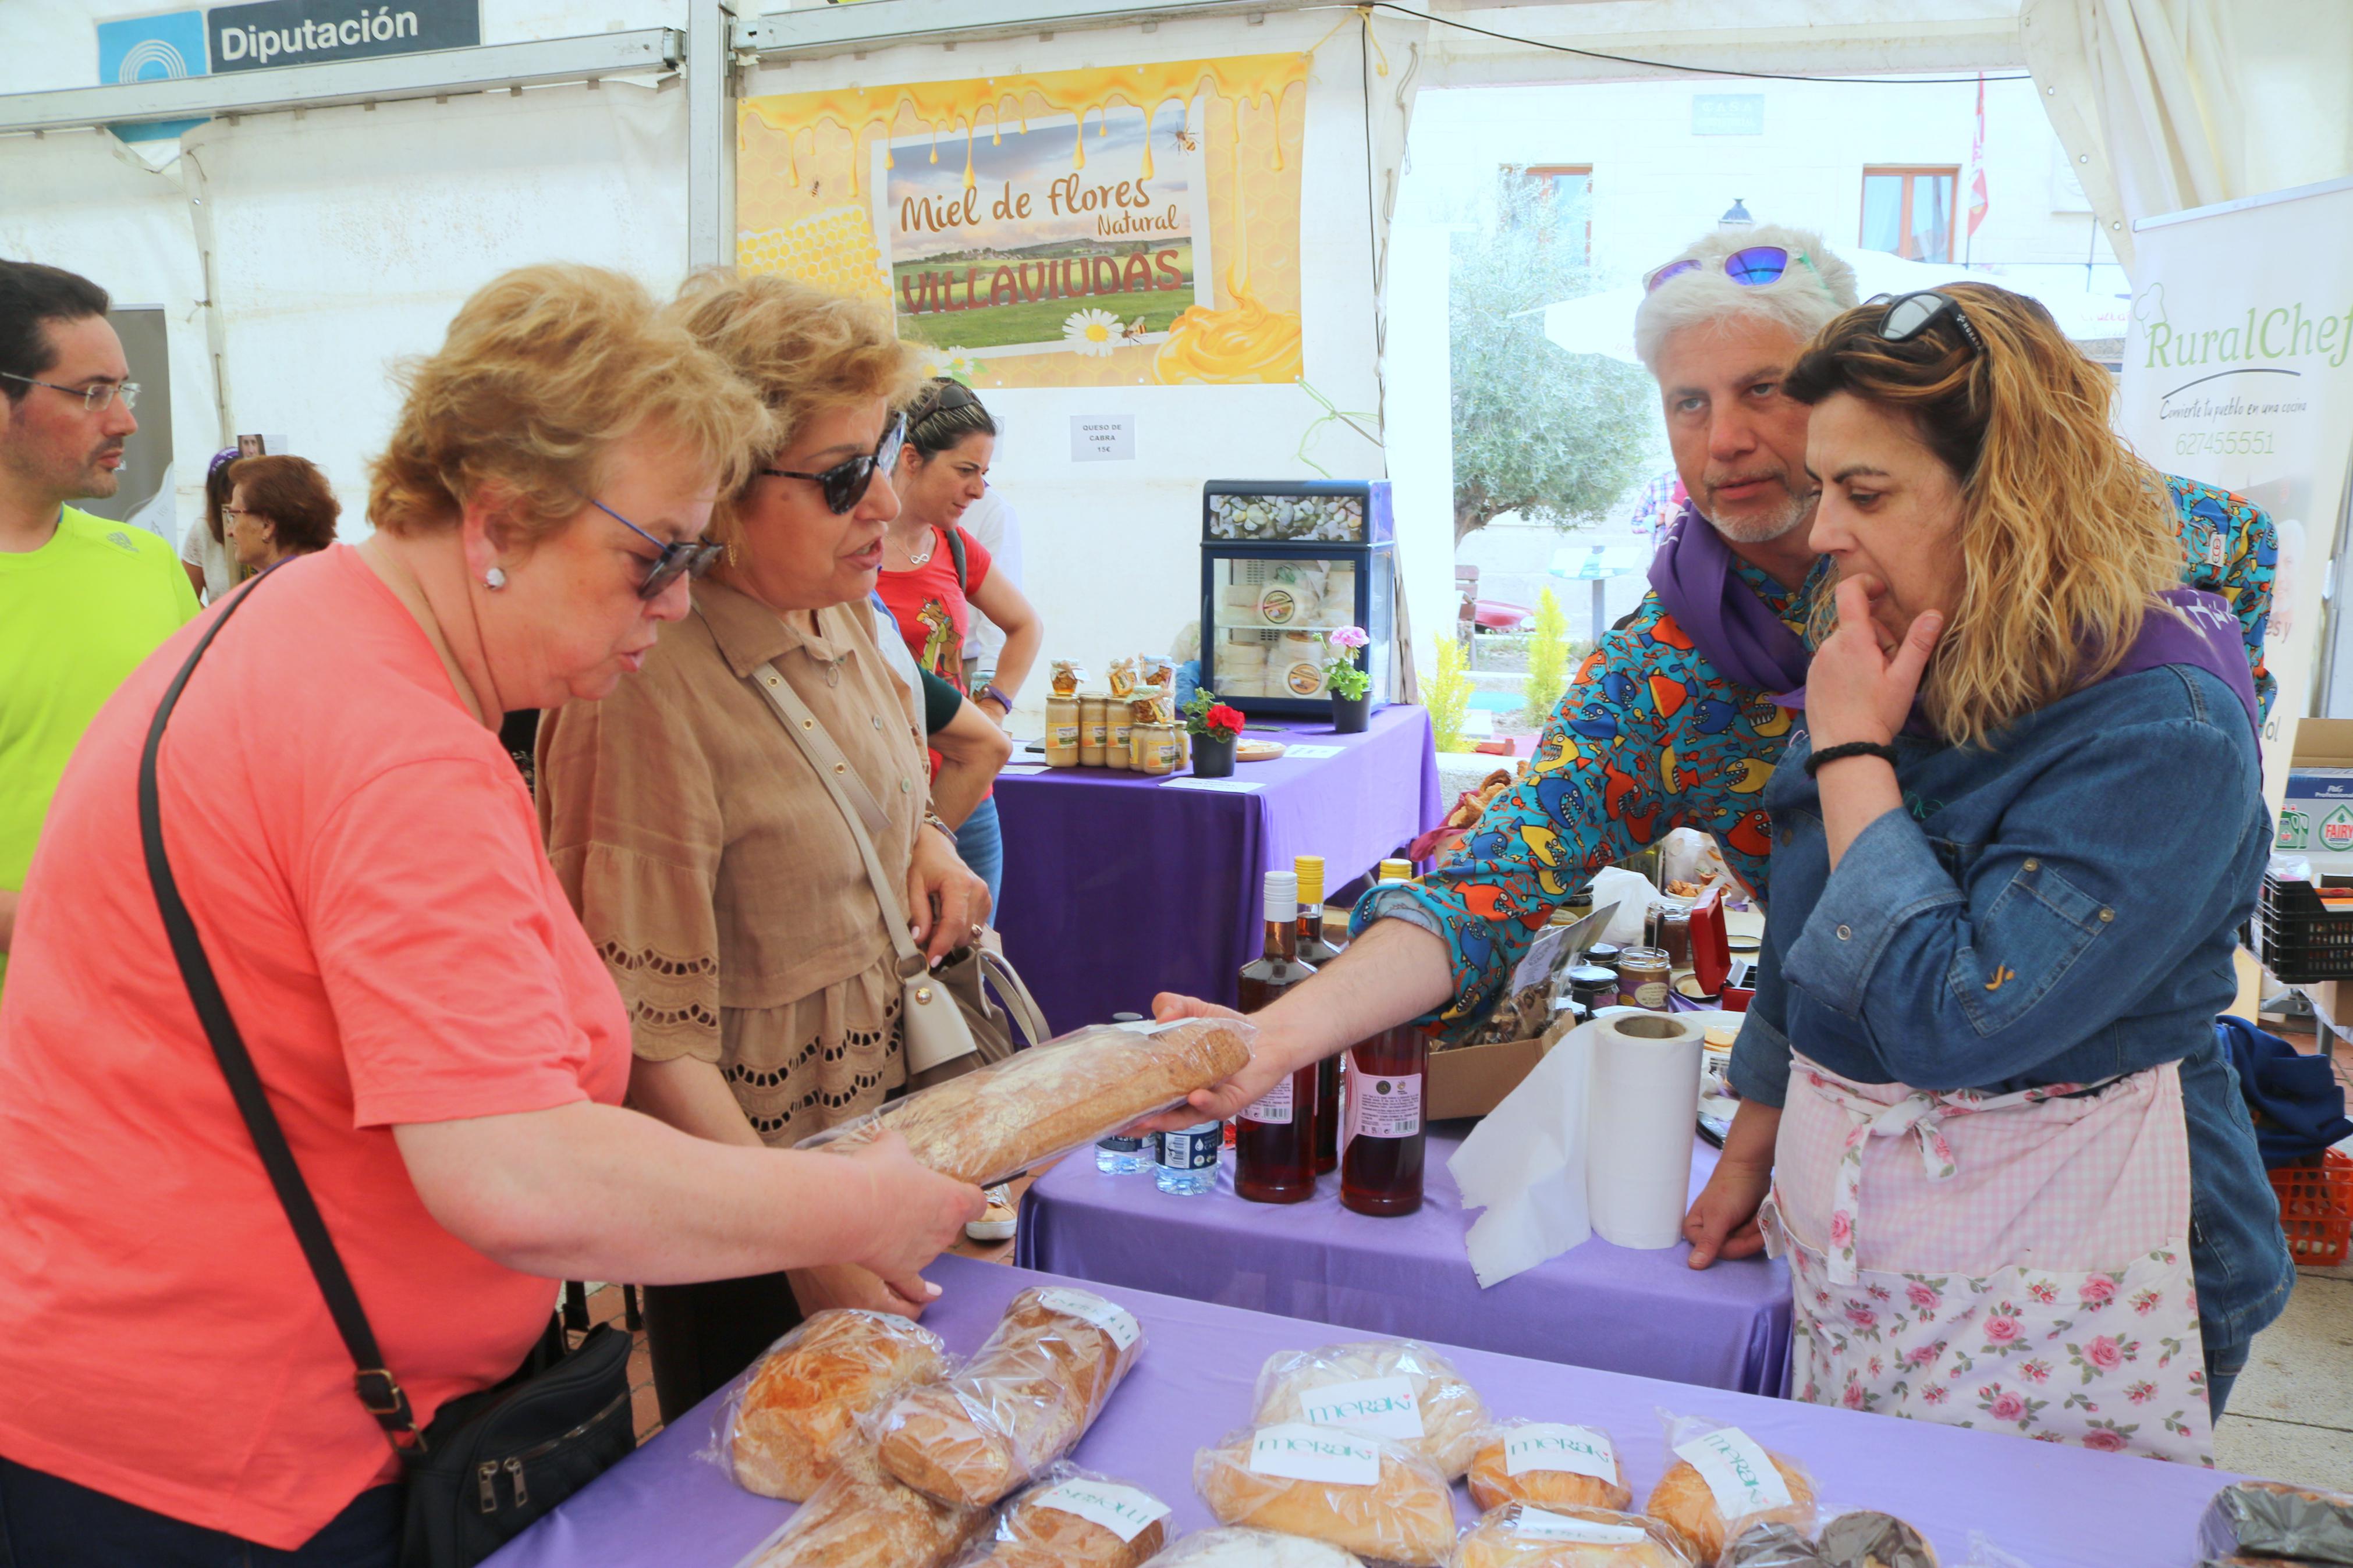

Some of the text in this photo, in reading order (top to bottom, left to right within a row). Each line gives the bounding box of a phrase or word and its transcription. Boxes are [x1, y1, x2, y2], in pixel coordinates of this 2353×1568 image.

[221, 5, 419, 64] Diputación
[902, 186, 981, 233] Miel
[993, 181, 1032, 221] de
[1098, 204, 1180, 236] Natural
[903, 250, 1184, 315] VILLAVIUDAS
[2145, 303, 2353, 368] RuralChef
[2160, 396, 2306, 423] Convierte tu pueblo en una cocina
[2175, 431, 2274, 455] 627455551
[2326, 824, 2353, 838] FAIRY
